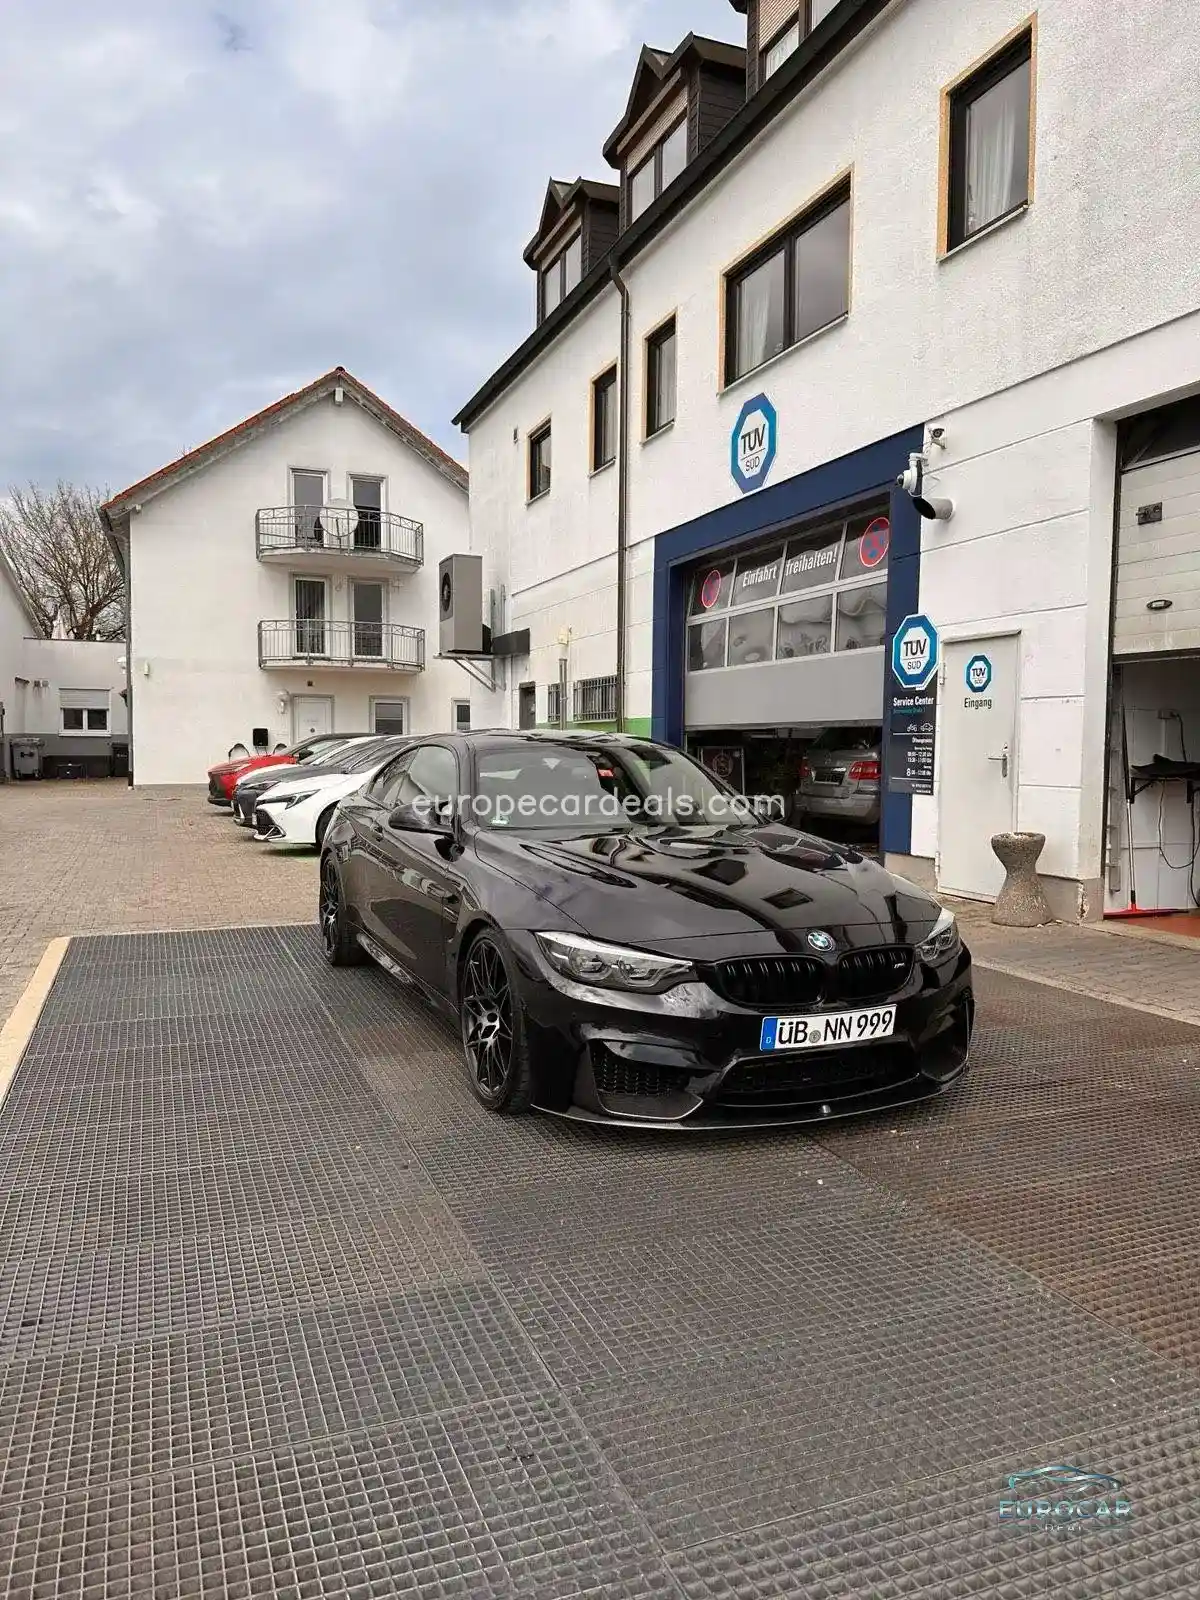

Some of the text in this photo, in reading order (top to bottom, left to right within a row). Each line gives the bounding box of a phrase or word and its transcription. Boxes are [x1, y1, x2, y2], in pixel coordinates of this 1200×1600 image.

[741, 424, 766, 454] TÜV
[742, 544, 838, 587] Einfahrt freihalten!
[903, 639, 927, 657] TÜV
[893, 695, 935, 707] Service Center
[964, 697, 993, 710] Eingang
[778, 1021, 808, 1045] ÜB
[823, 1015, 853, 1041] NN
[856, 1009, 893, 1038] 999
